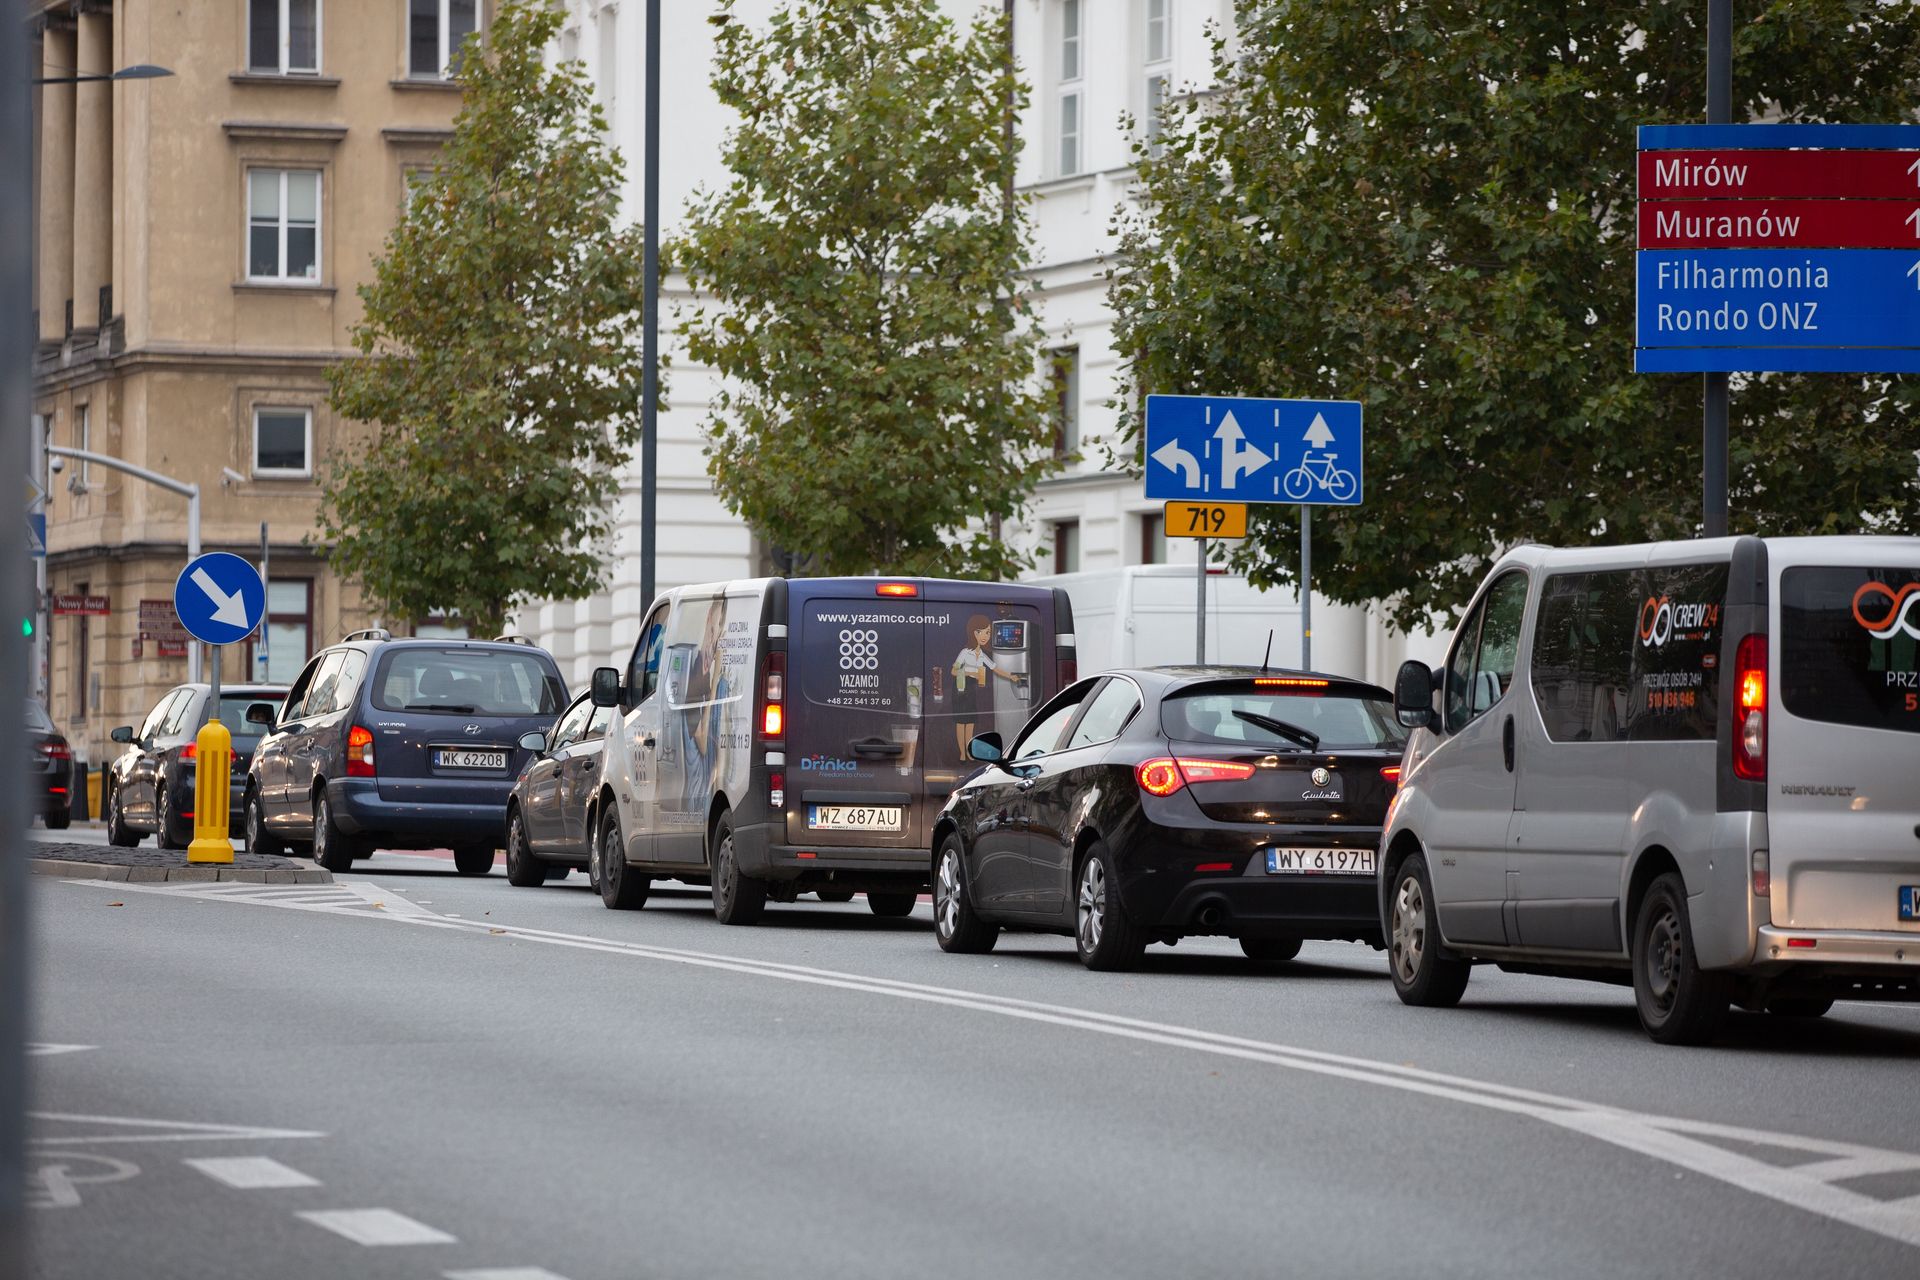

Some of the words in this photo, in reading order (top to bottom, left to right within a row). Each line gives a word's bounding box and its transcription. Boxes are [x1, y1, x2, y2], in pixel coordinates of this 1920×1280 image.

[1655, 158, 1748, 187] Mirów
[1656, 208, 1800, 238] Muranów
[1657, 259, 1829, 289] Filharmonia
[1658, 301, 1749, 331] Rondo
[1758, 302, 1819, 330] ONZ
[1186, 507, 1226, 532] 719
[816, 613, 950, 627] www.yazamco.com.pl
[1673, 603, 1719, 628] CREW24
[840, 674, 879, 688] YAZAMCO
[1886, 671, 1920, 688] PRZ
[826, 697, 841, 705] +48
[843, 697, 853, 705] 22
[854, 697, 868, 705] 541
[442, 752, 459, 765] WK
[463, 753, 503, 767] 62208
[801, 755, 857, 771] Drinka
[1301, 790, 1341, 801] Giulietta
[1781, 784, 1856, 797] RENAULT
[820, 808, 841, 824] WZ
[847, 808, 897, 825] 687AU
[1279, 850, 1306, 869] WY
[1314, 850, 1373, 870] 6197H
